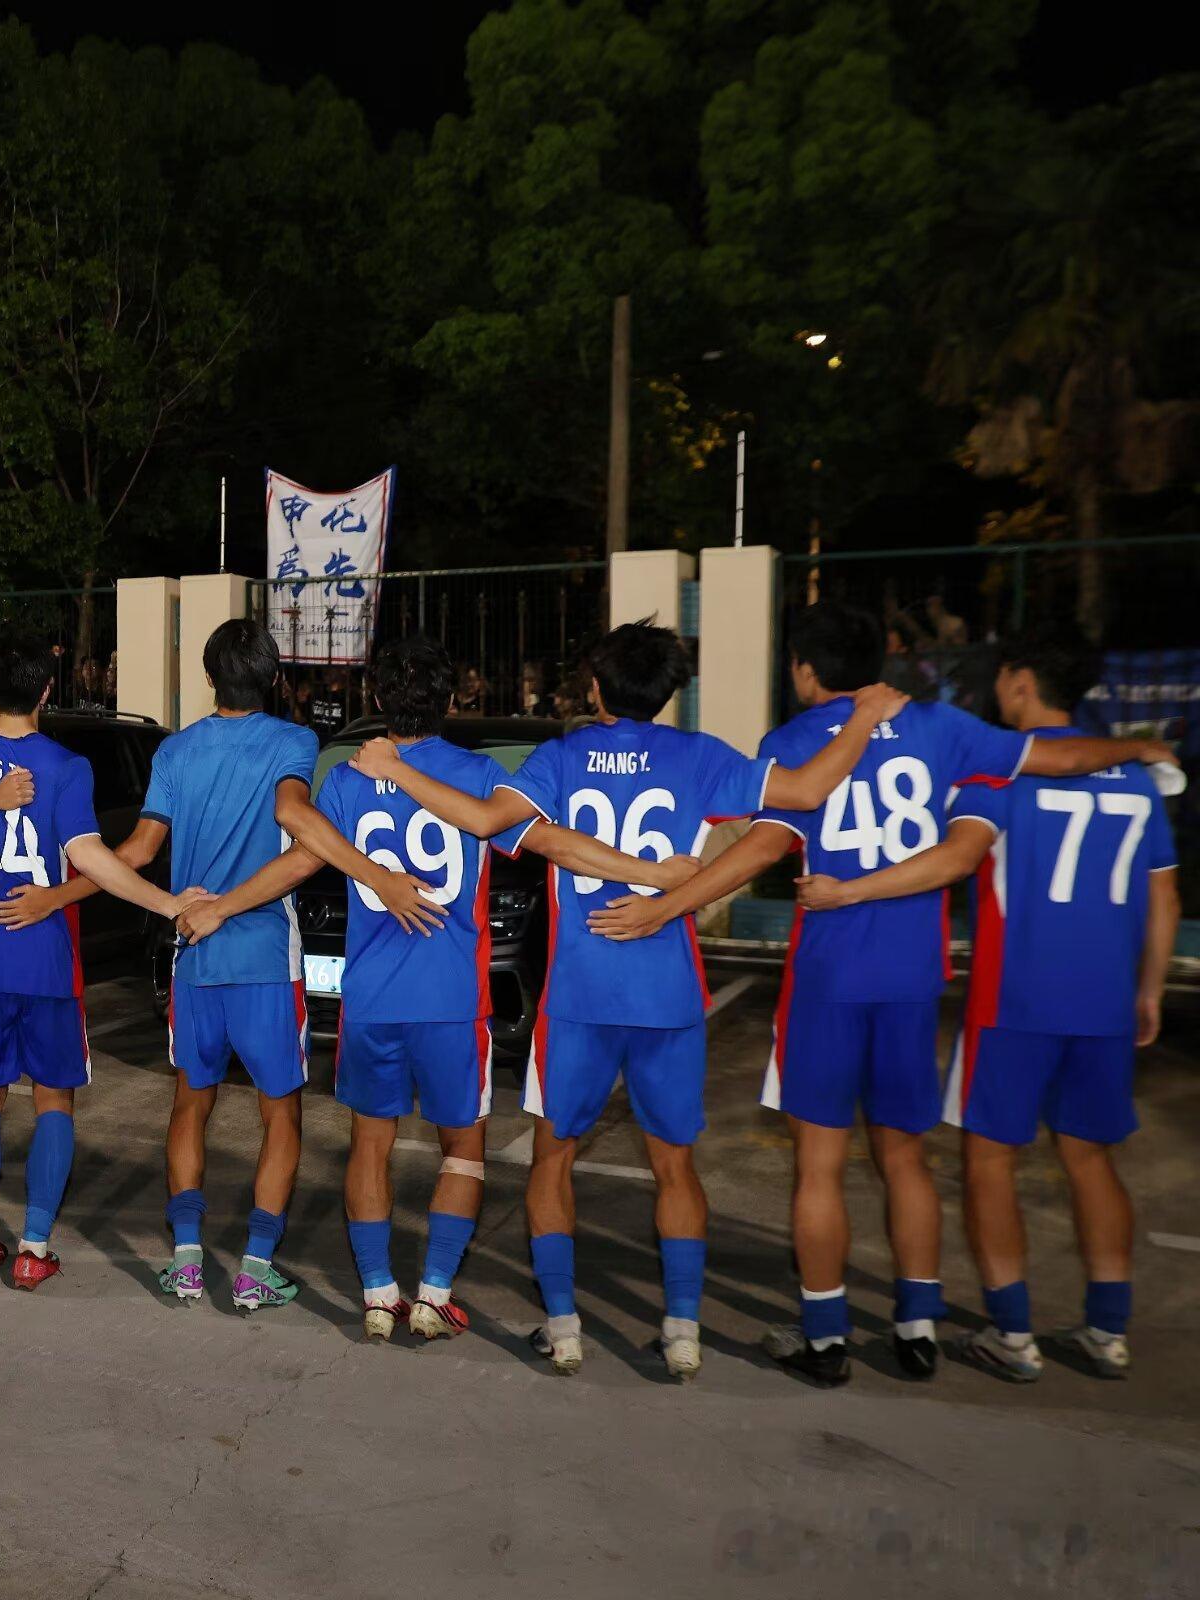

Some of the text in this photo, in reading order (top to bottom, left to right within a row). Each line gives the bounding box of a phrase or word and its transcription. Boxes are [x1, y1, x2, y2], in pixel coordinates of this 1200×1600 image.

[587, 750, 650, 774] ZHANG Y.
[820, 755, 939, 870] 48
[353, 808, 463, 912] 69
[1036, 788, 1152, 906] 77
